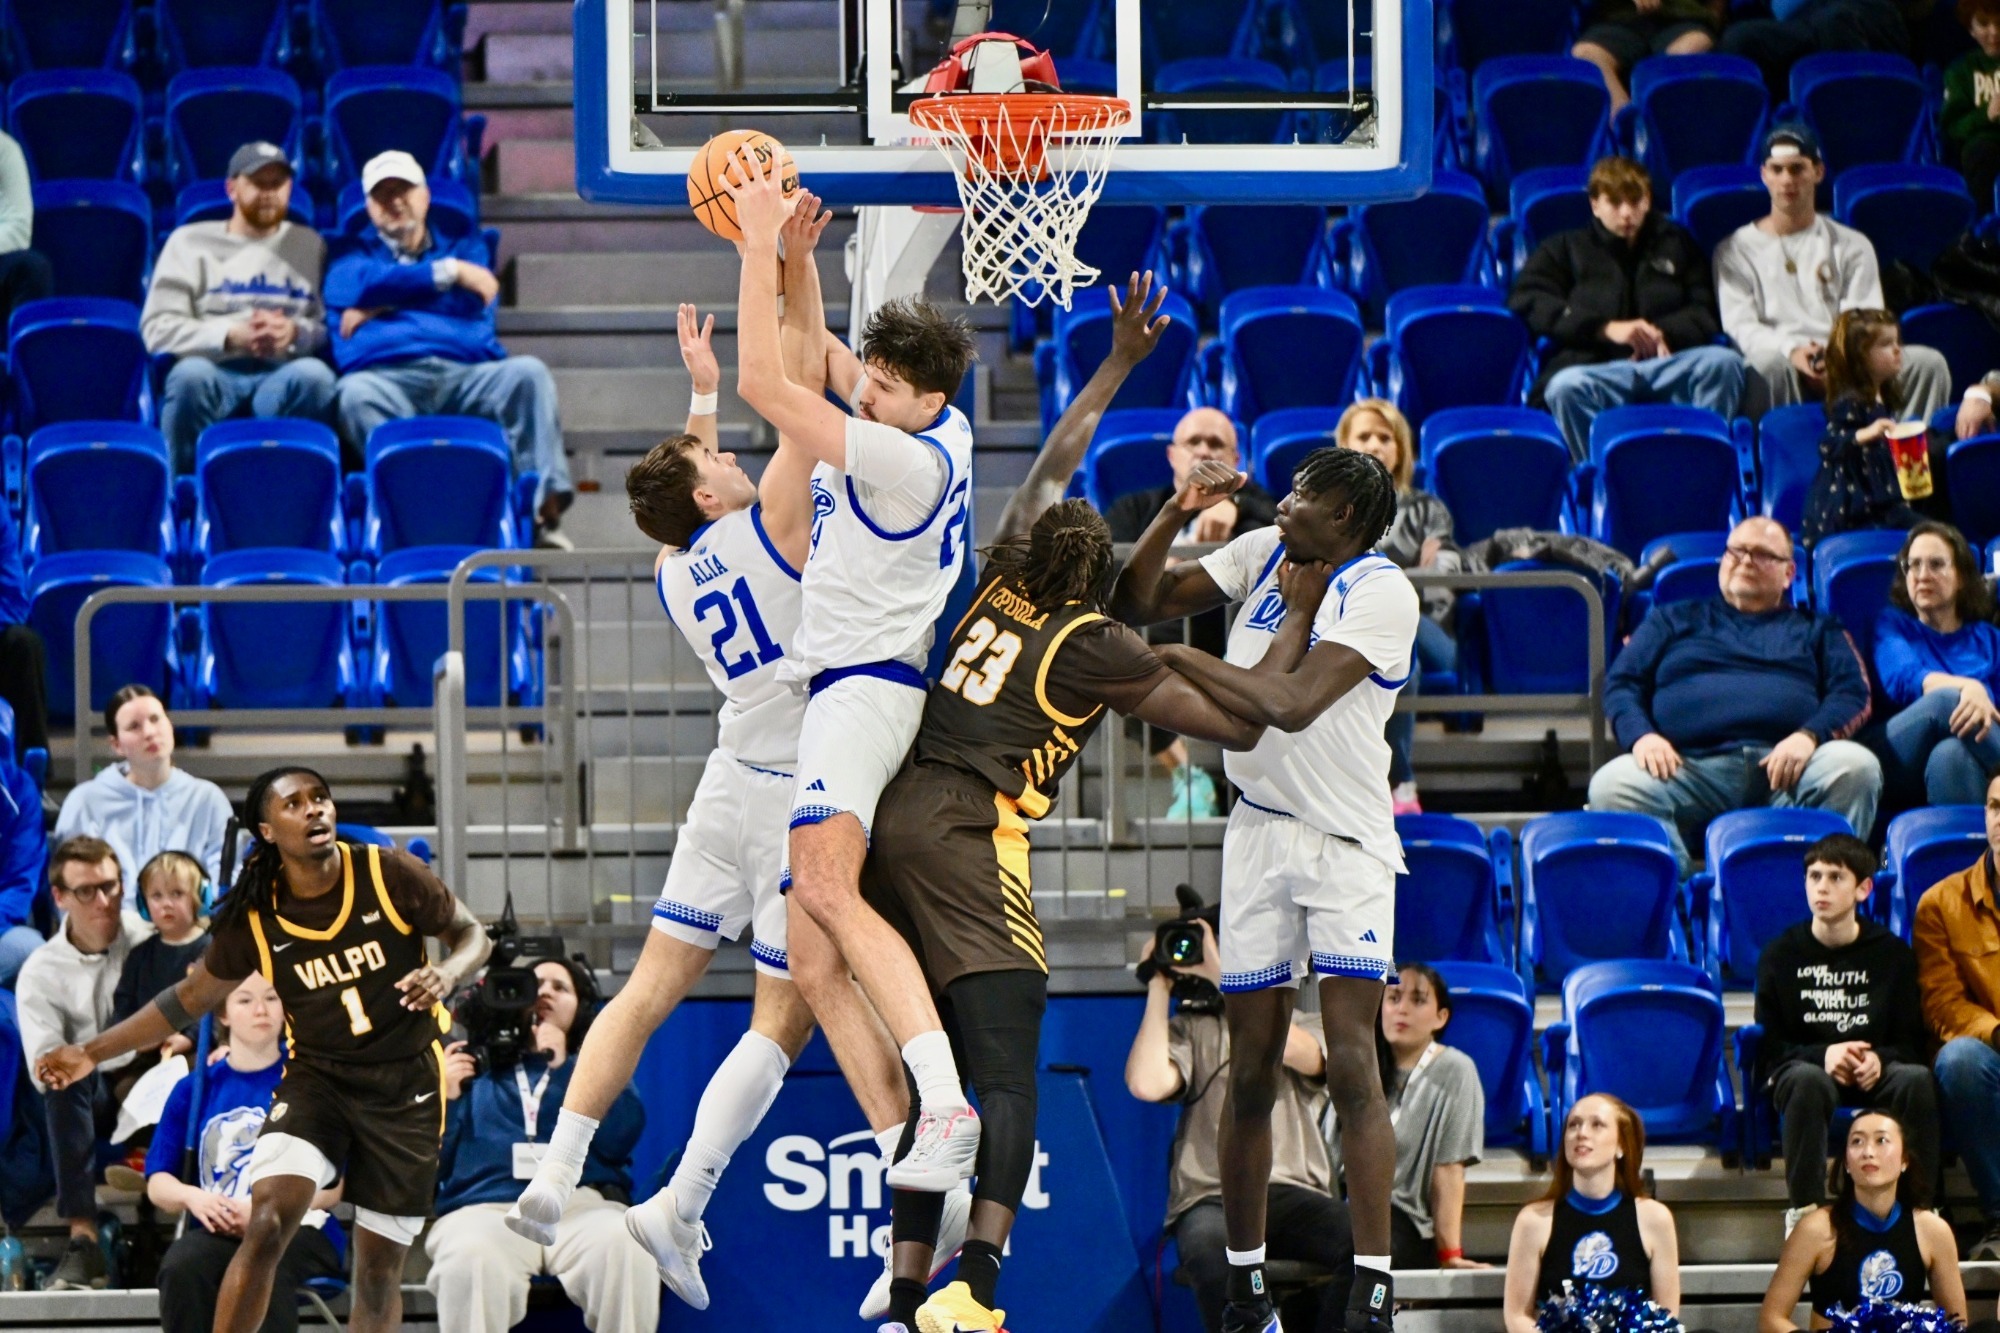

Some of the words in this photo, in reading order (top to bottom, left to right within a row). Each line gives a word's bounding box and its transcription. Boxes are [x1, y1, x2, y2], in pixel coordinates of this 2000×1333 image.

[688, 553, 729, 587] ALIA
[693, 575, 785, 681] 21
[939, 616, 1023, 706] 23
[293, 940, 387, 990] VALPO
[1797, 964, 1829, 979] LOVE
[340, 986, 373, 1036] 1
[1803, 1012, 1851, 1023] GLORIFY
